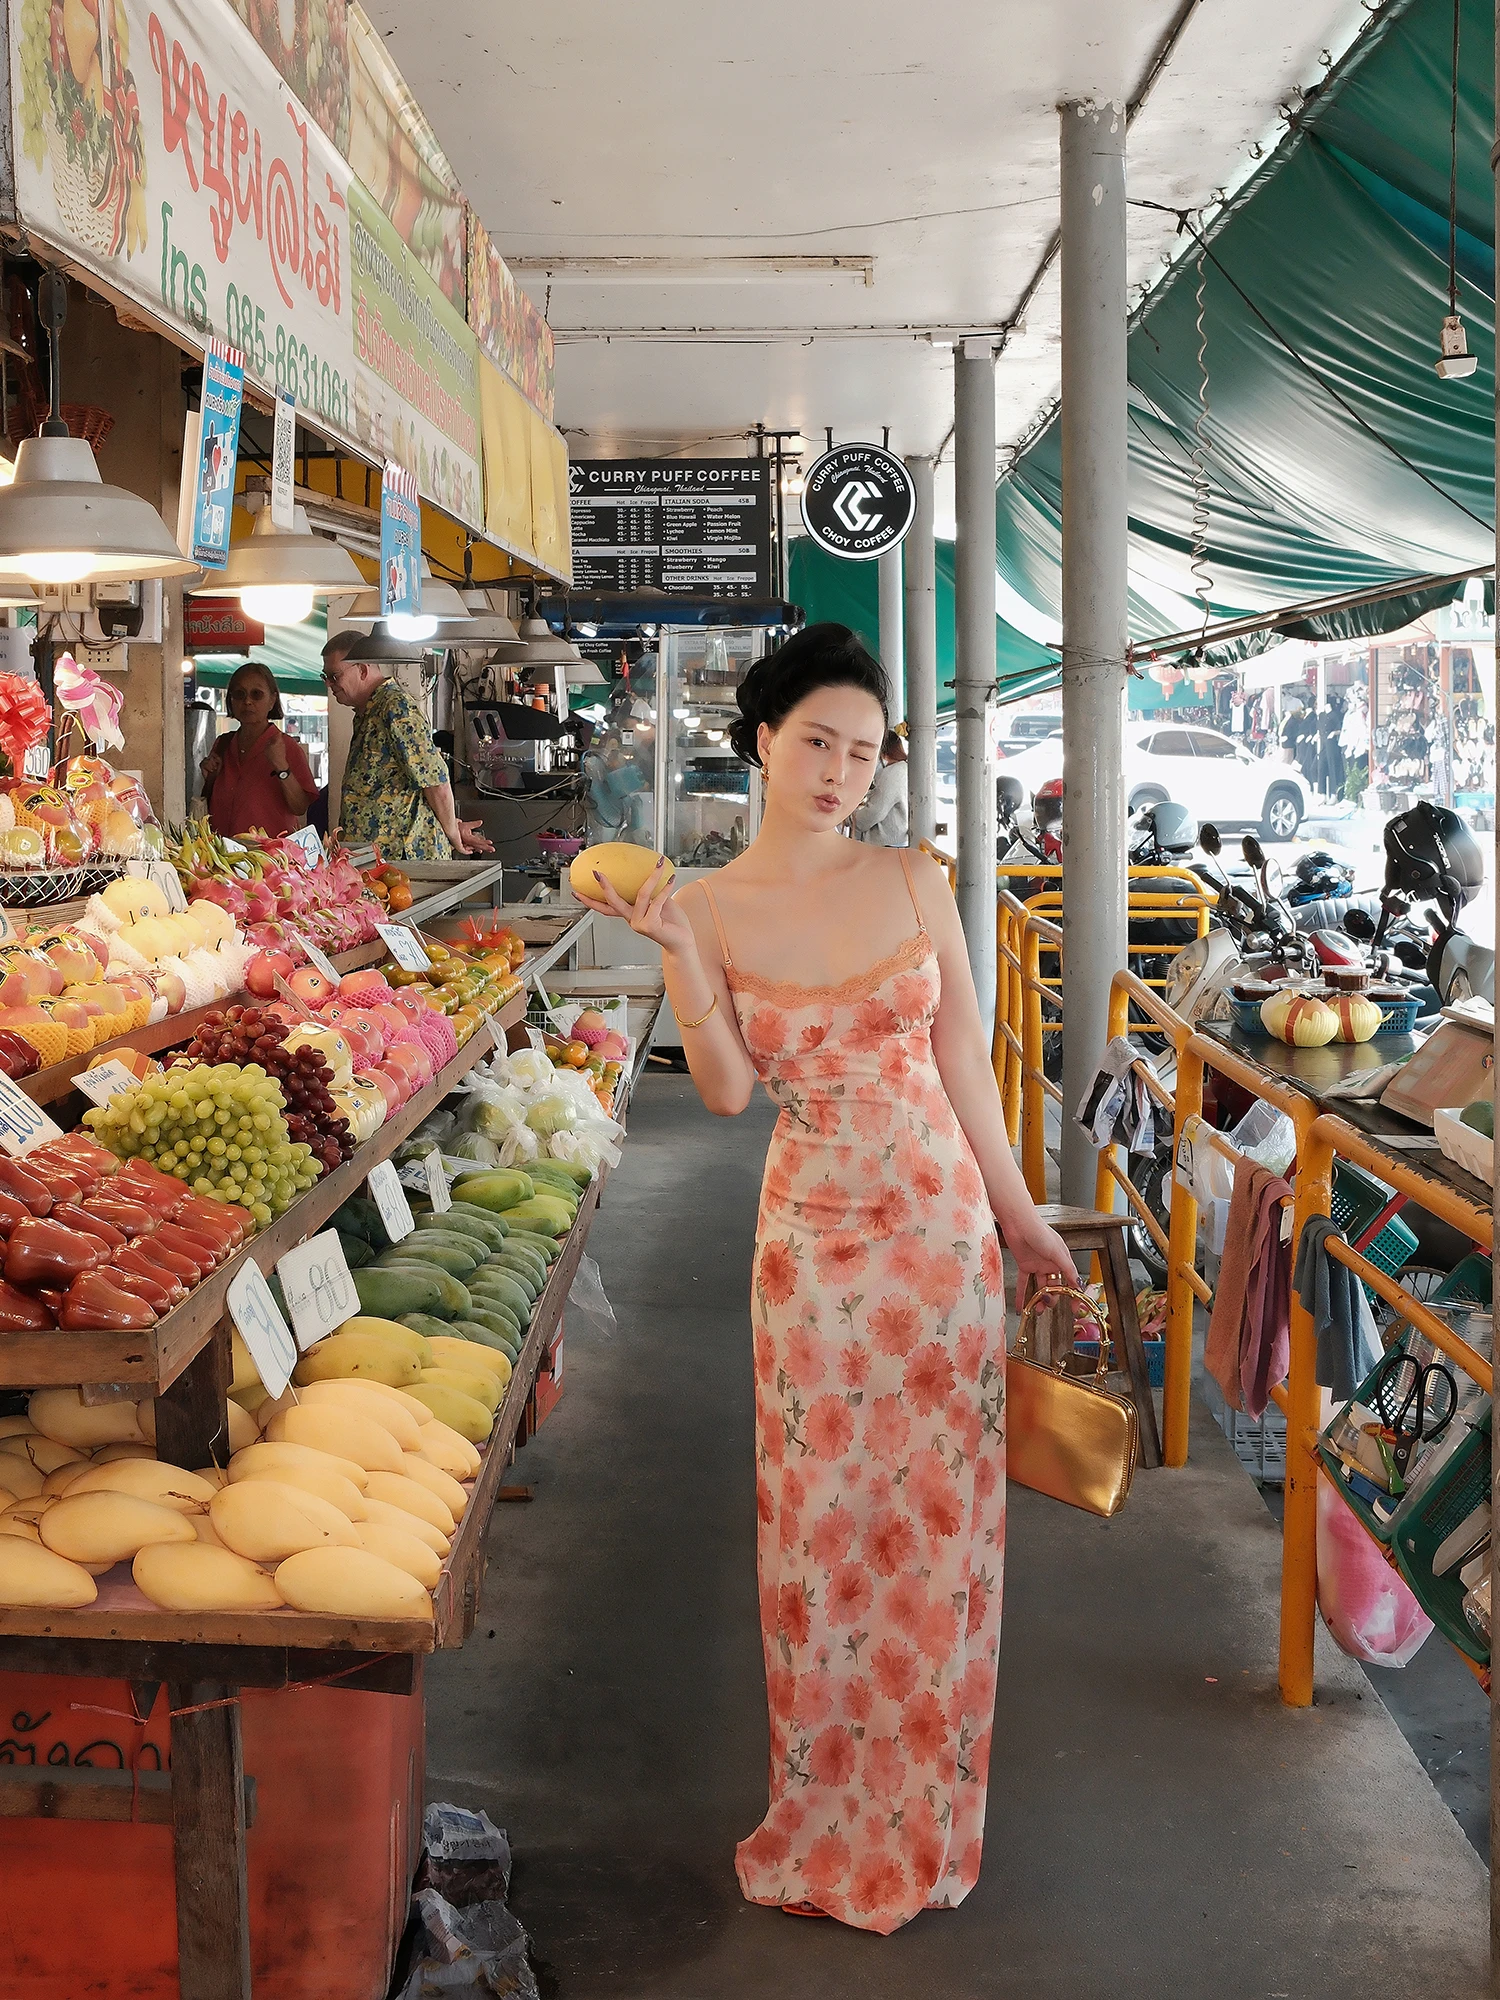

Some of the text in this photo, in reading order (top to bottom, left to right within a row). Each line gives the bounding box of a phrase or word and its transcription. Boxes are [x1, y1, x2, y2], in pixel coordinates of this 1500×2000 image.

[589, 470, 760, 482] CURRY PUFF COFFEE
[812, 453, 905, 493] CURRY PUFF COFFEE
[864, 464, 888, 484] Thailand
[674, 484, 705, 492] Thailand
[822, 525, 895, 548] CHOY COFFEE
[308, 1256, 350, 1323] 80
